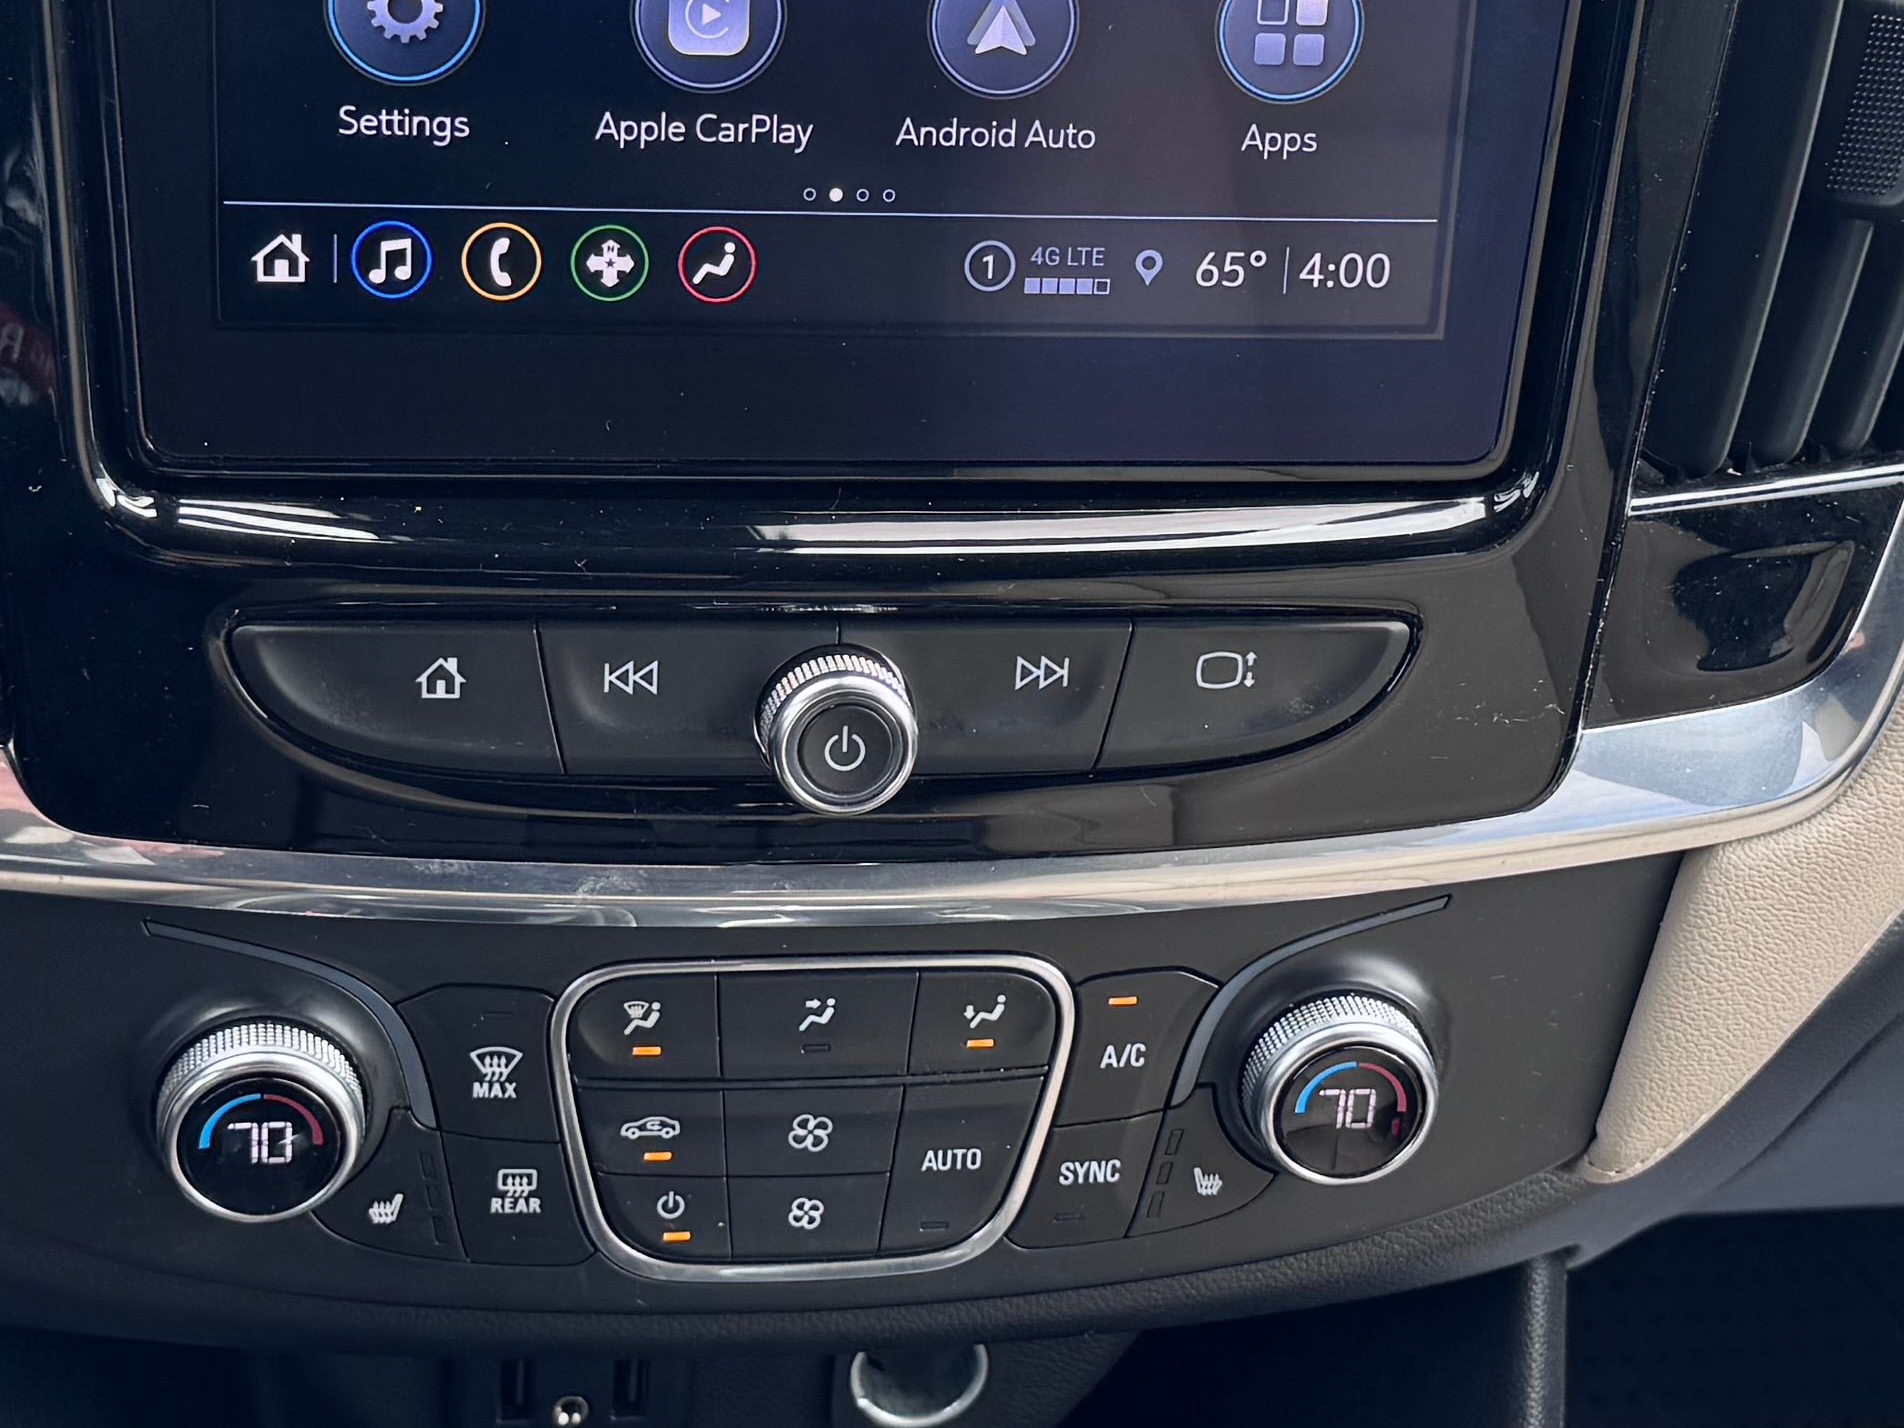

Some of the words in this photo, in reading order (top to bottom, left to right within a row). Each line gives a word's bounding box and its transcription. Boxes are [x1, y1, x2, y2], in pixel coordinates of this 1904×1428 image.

[338, 106, 471, 146] Settings
[596, 112, 686, 149] Apple
[695, 114, 814, 153] CarPlay
[895, 117, 1016, 149] Android
[1024, 120, 1096, 149] Auto
[1241, 124, 1319, 160] Apps
[1030, 247, 1061, 266] 4G
[1067, 247, 1106, 267] LTE
[1196, 250, 1268, 288] 65°
[1299, 252, 1392, 289] 4:00
[1100, 1043, 1147, 1069] A/C
[472, 1082, 518, 1099] MAX
[1318, 1088, 1376, 1130] 70
[227, 1120, 294, 1165] 70
[921, 1148, 982, 1172] AUTO
[1058, 1158, 1122, 1186] SYNC
[490, 1197, 542, 1214] REAR
